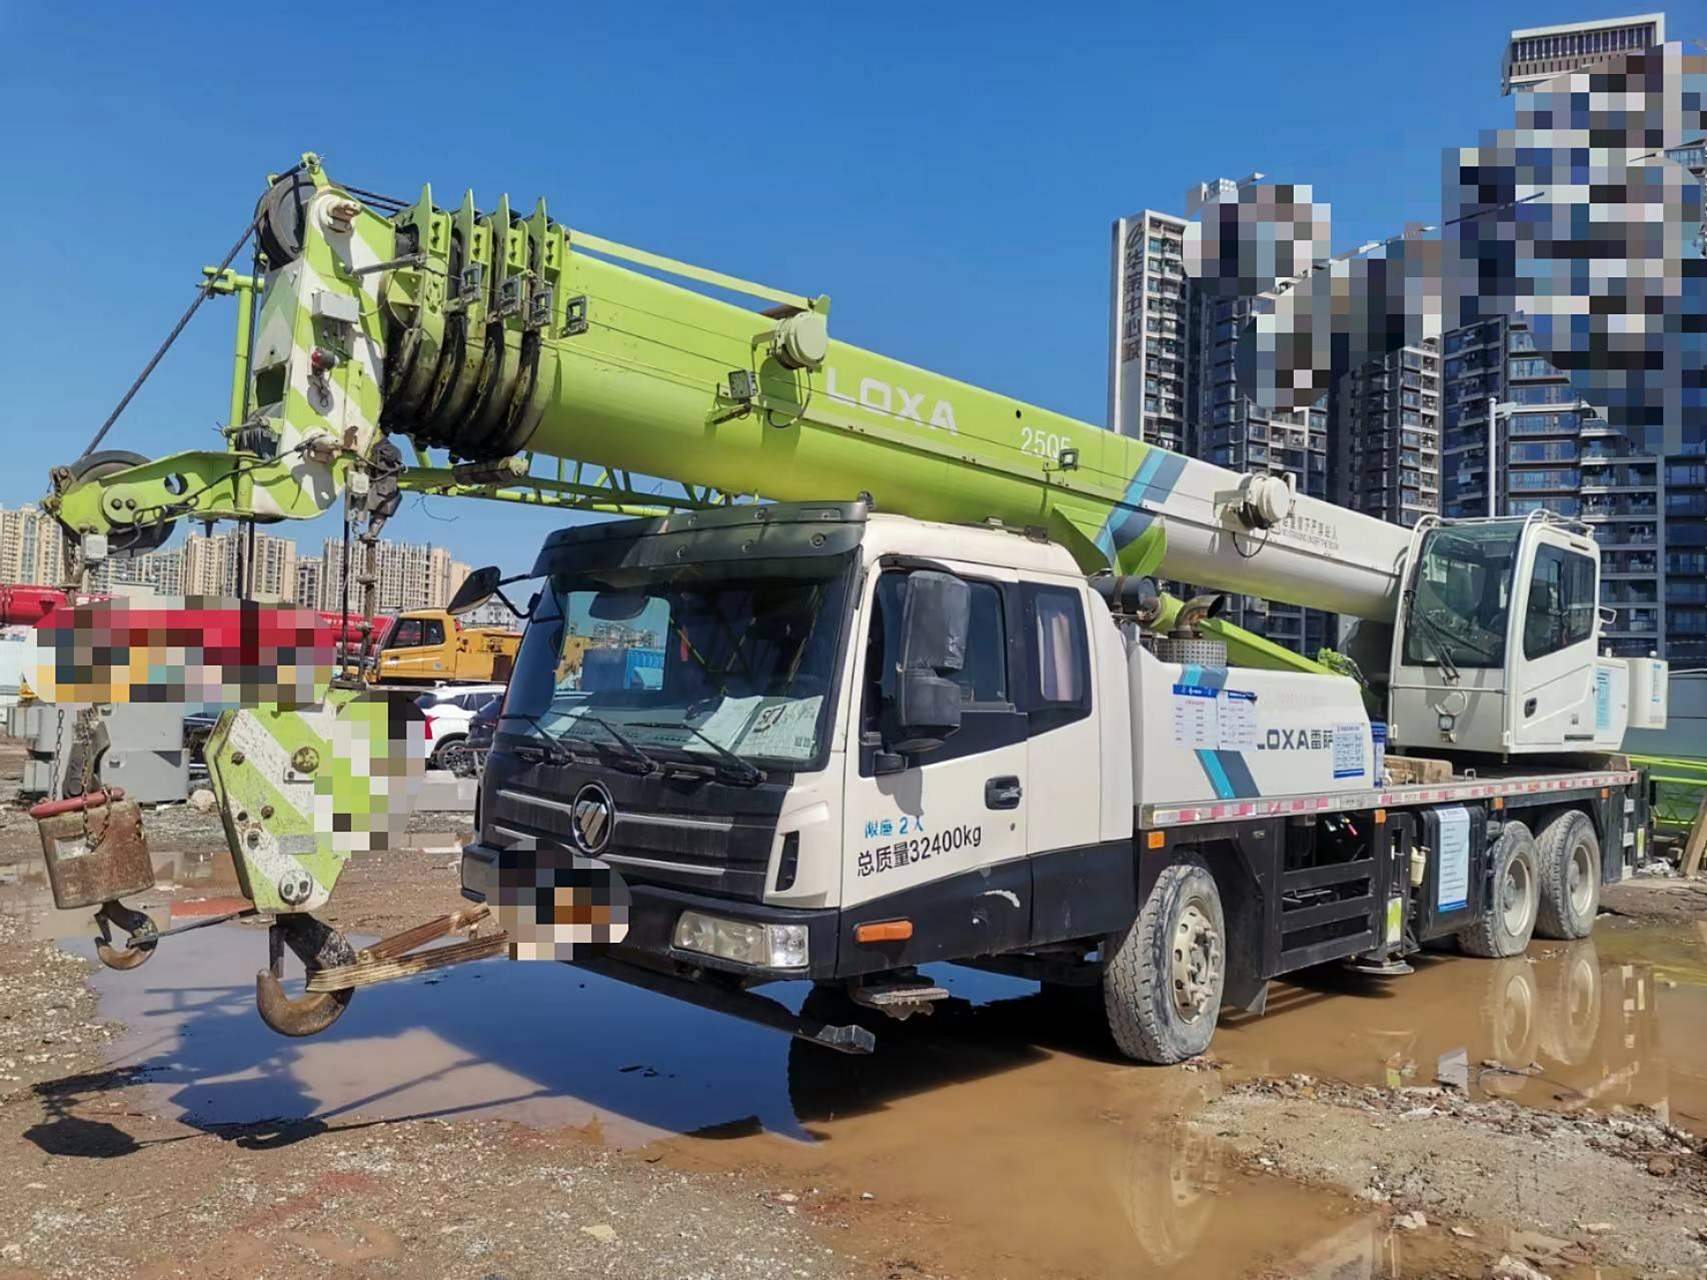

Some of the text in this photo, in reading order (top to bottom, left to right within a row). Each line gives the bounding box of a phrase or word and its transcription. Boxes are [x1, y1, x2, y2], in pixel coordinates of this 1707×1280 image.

[826, 367, 958, 436] LOXA
[857, 825, 982, 877] 总质量32400kg
